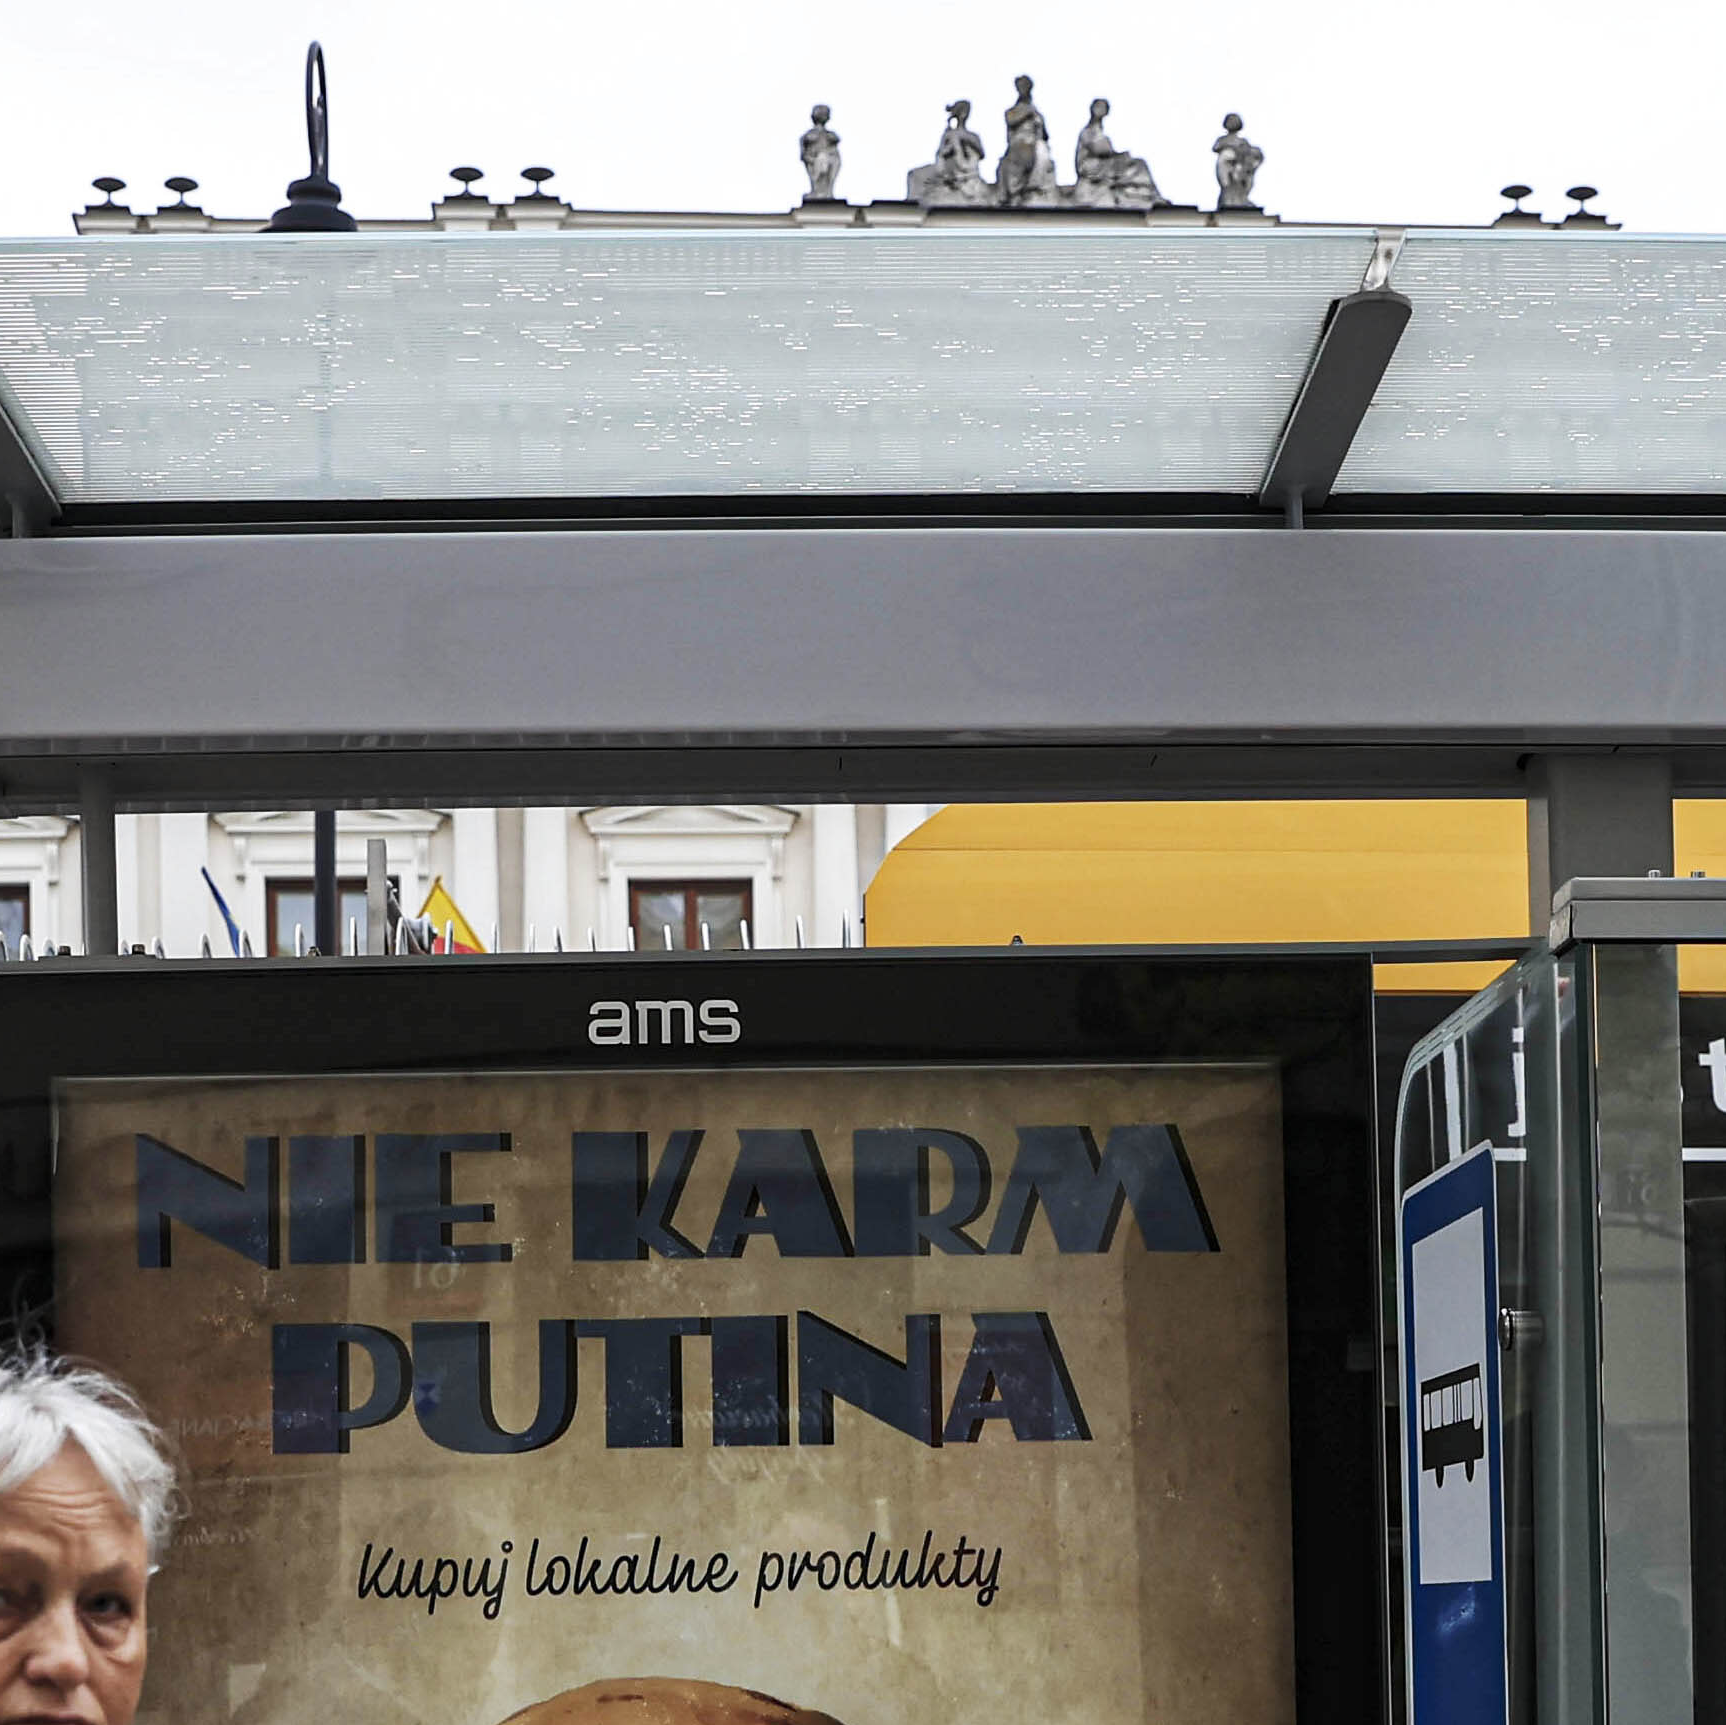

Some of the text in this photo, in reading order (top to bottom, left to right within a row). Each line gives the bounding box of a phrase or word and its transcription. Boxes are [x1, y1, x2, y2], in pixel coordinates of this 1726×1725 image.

[587, 999, 742, 1045] ams
[136, 1123, 1222, 1271] NIE KARM
[270, 1310, 1094, 1455] PUTINA
[357, 1530, 1003, 1620] Kupuj lokalne produkty
